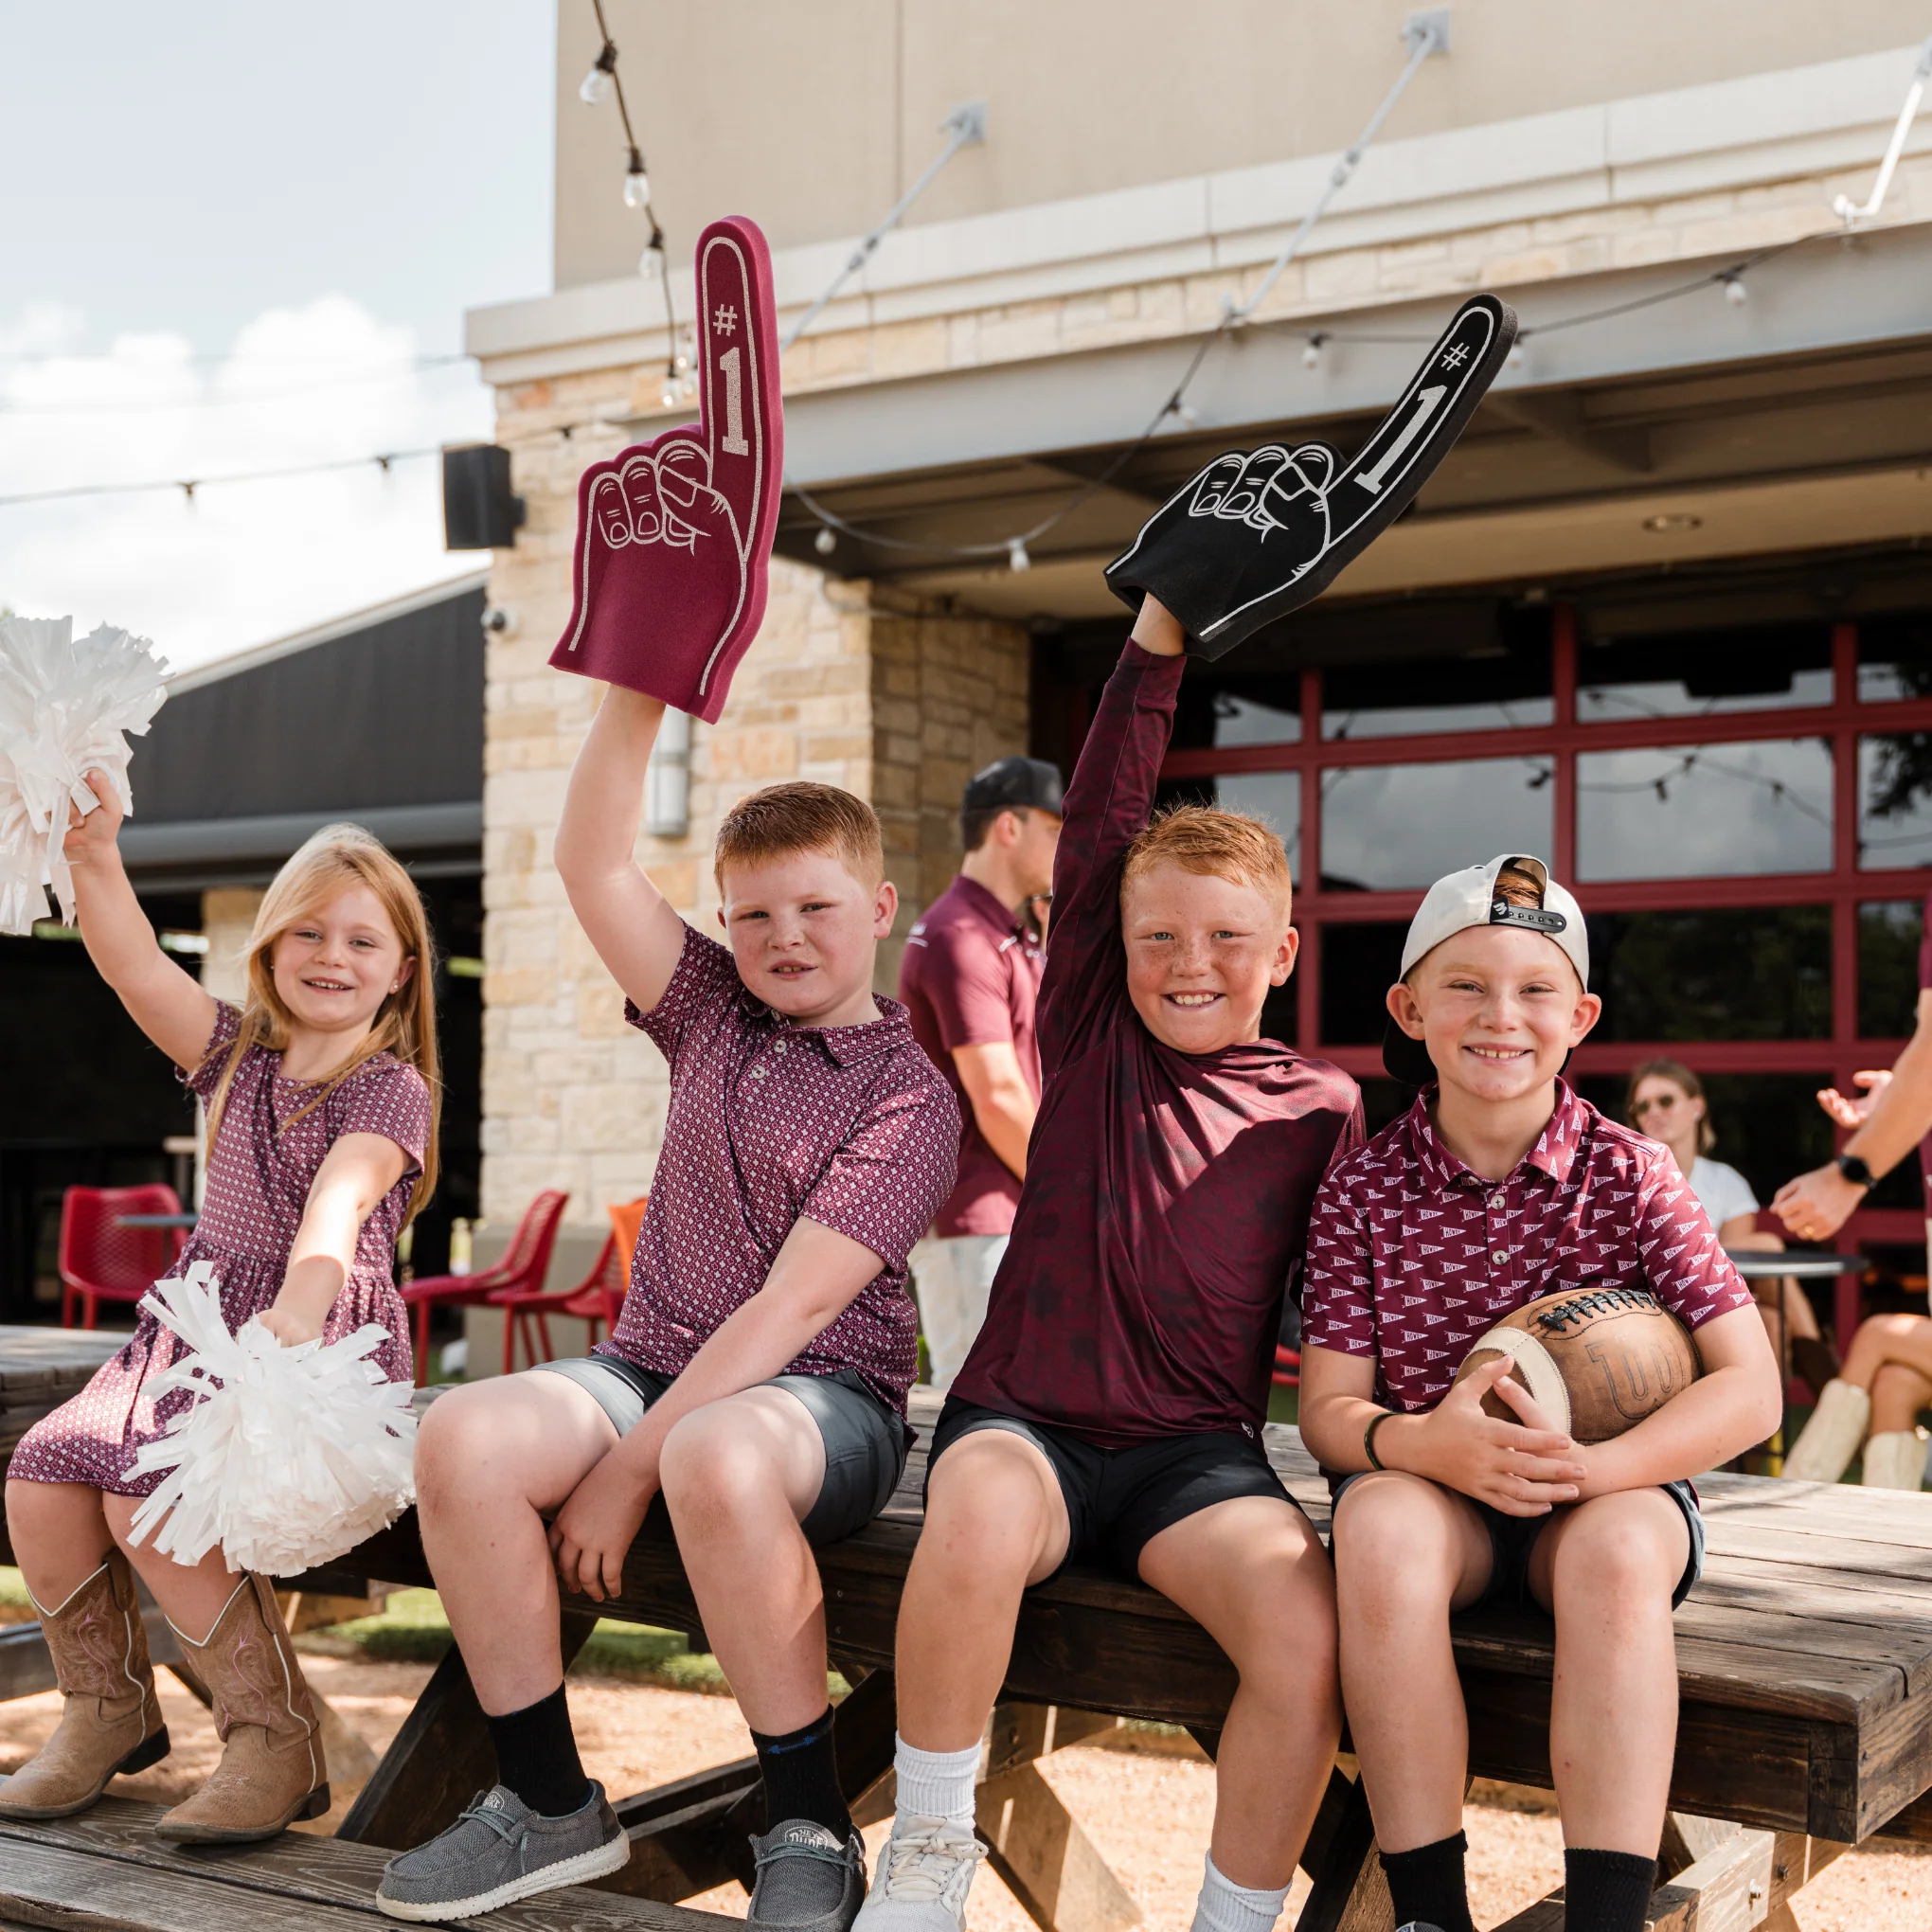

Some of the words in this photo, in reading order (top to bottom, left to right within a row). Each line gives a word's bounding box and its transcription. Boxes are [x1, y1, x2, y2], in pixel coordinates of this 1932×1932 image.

[713, 304, 738, 336] #
[1441, 343, 1469, 370] #
[720, 347, 748, 456] 1
[1353, 385, 1447, 494] 1
[1562, 1185, 1576, 1193] HOWDY
[1443, 1193, 1458, 1202] HOWDY
[1614, 1191, 1629, 1200] HOWDY
[1543, 1204, 1558, 1213] HOWDY
[1385, 1209, 1399, 1218] HOWDY
[1422, 1210, 1439, 1219] HOWDY
[1464, 1210, 1480, 1219] HOWDY
[1594, 1210, 1611, 1219] HOWDY
[1652, 1214, 1670, 1228] HOWDY
[1337, 1225, 1352, 1234] HOWDY
[1444, 1228, 1460, 1237] HOWDY
[1526, 1225, 1539, 1234] HOWDY
[1679, 1223, 1695, 1234] HOWDY
[1318, 1237, 1332, 1245] HOWDY
[1385, 1244, 1399, 1253] HOWDY
[1422, 1245, 1439, 1254] HOWDY
[1466, 1245, 1482, 1255] HOWDY
[1600, 1245, 1616, 1254] HOWDY
[1639, 1241, 1655, 1255] HOWDY
[1664, 1246, 1683, 1259] HOWDY
[1404, 1261, 1419, 1270] HOWDY
[1445, 1263, 1461, 1272] HOWDY
[1527, 1260, 1543, 1269] HOWDY
[1581, 1264, 1598, 1273] HOWDY
[1619, 1261, 1634, 1270] HOWDY
[1655, 1271, 1668, 1284] HOWDY
[1385, 1279, 1400, 1287] HOWDY
[1424, 1280, 1440, 1289] HOWDY
[1466, 1281, 1483, 1291] HOWDY
[1562, 1280, 1577, 1289] HOWDY
[1676, 1277, 1695, 1289] HOWDY
[1333, 1289, 1349, 1297] HOWDY
[1706, 1284, 1722, 1294] HOWDY
[1405, 1297, 1422, 1306] HOWDY
[1446, 1298, 1463, 1307] HOWDY
[1352, 1307, 1368, 1315] HOWDY
[1691, 1306, 1711, 1319] HOWDY
[1384, 1313, 1400, 1322] HOWDY
[1427, 1315, 1443, 1324] HOWDY
[1469, 1316, 1486, 1325] HOWDY
[1330, 1321, 1346, 1330] HOWDY
[1405, 1332, 1423, 1341] HOWDY
[1449, 1333, 1466, 1342] HOWDY
[1428, 1351, 1444, 1359] HOWDY
[1405, 1367, 1422, 1376] HOWDY
[1426, 1384, 1443, 1392] HOWDY
[1405, 1401, 1422, 1409] HOWDY
[799, 1829, 817, 1838] HEY
